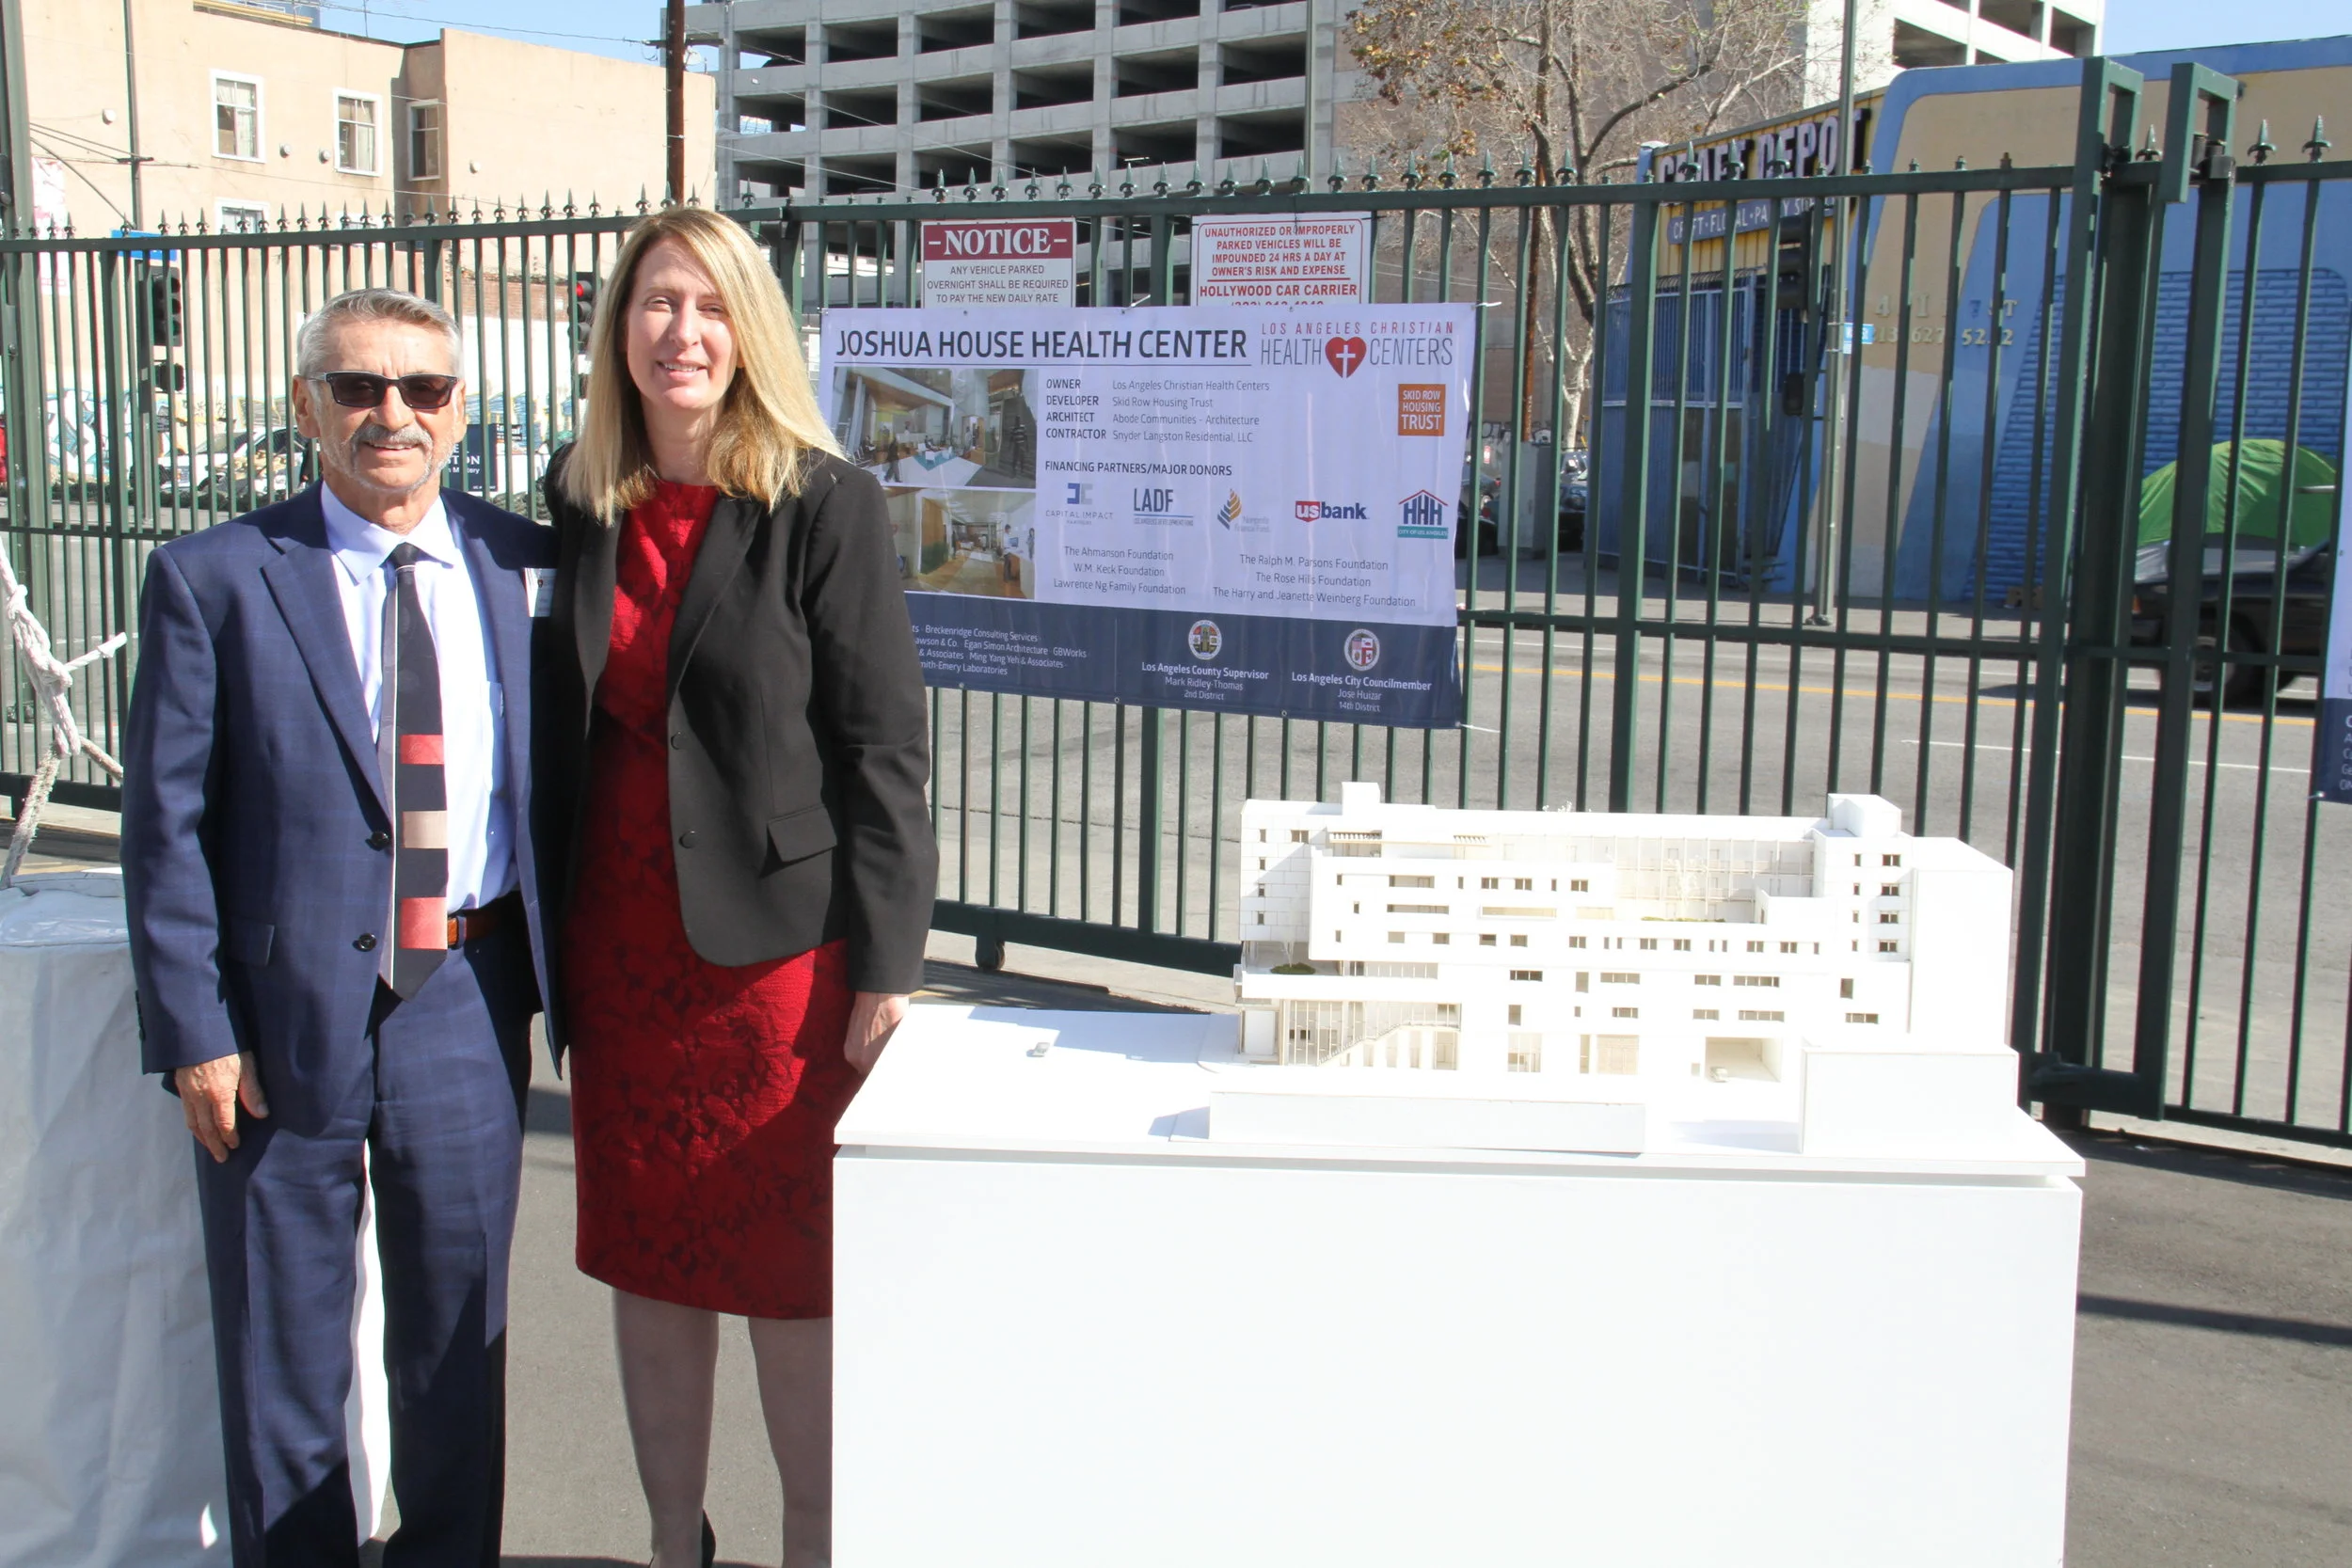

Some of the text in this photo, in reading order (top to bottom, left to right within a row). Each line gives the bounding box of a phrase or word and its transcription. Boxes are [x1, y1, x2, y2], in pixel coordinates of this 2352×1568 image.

[1673, 217, 1704, 239] CFT
[1710, 208, 1748, 232] FLOAL
[1755, 198, 1789, 224] PAY
[1205, 225, 1356, 237] UNAUTHORIZED OR IMPROPERLY
[944, 229, 1051, 255] NOTICE
[1216, 238, 1341, 250] PARKED VEHICLES WILL BE
[1213, 251, 1345, 263] IMPOUNDED 24 HRS A DAY AT
[950, 265, 1044, 275] ANY VEHICLE PARKED
[1212, 265, 1345, 277] OWNER'S RISK AND EXPENSE
[928, 279, 1069, 289] OVERNIGHT SHALL BE REQUIRED
[1200, 284, 1358, 296] HOLLYWOOD CAR CARRIER
[936, 294, 947, 303] TO
[949, 294, 966, 303] PAY
[1008, 293, 1033, 302] DAILY
[1036, 293, 1058, 302] RATE
[1262, 322, 1454, 335] LOS ANGELES CHRISTIAN
[1873, 326, 1898, 343] 13
[1962, 328, 2013, 345] 522
[835, 329, 1248, 358] JOSHUA HOUSE HEALTH CENTER
[1261, 338, 1453, 366] HEALTH CENTERS
[1046, 379, 1270, 392] OWNER Los Angeles Christian Health Centers
[1046, 395, 1214, 410] DEVELOPER Skid Row Housing Trust
[1403, 390, 1441, 400] SKID ROW
[1403, 403, 1440, 413] HOUSING
[1046, 412, 1095, 422] ARCHITECT
[1112, 414, 1139, 423] Abode
[1140, 414, 1197, 424] Communities
[1206, 415, 1260, 425] Architecture
[1401, 414, 1442, 430] TRUST
[1046, 428, 1106, 439] CONTRACTOR
[1113, 430, 1141, 442] Snyder
[1143, 431, 1184, 443] Langston
[1237, 433, 1253, 442] LLC
[1045, 461, 1232, 476] FINANCING PARTNERS/MAJOR DONORS
[1133, 488, 1173, 512] LADF
[1045, 510, 1079, 518] CAPITAL
[1403, 494, 1442, 526] HHH
[1064, 546, 1174, 561] The Ahmanson Foundation
[1097, 563, 1116, 574] Keck
[1118, 565, 1165, 577] Foundation
[1240, 554, 1256, 564] The
[1258, 555, 1282, 567] Ralph
[1298, 557, 1333, 568] Parsons
[1336, 559, 1389, 571] Foundation
[1054, 578, 1185, 594] Lawrence Ng Family Foundation
[1256, 572, 1371, 586] The Rose Hills Foundation
[1214, 586, 1416, 607] The Harry and Jeanette Weinberg Foundation
[925, 625, 972, 639] Breckenridge
[974, 628, 1009, 641] Consulting
[1009, 631, 1038, 641] Services
[914, 637, 939, 646] awson
[964, 640, 981, 651] Egan
[983, 641, 1005, 651] Simon
[1006, 642, 1049, 656] Architecture
[918, 648, 1064, 669] & Associates Ming Yang Yeh & Associates
[920, 660, 1008, 675] mith-Emery Laboratories
[1141, 662, 1269, 680] Los Angeles County Supervisor
[1165, 676, 1244, 691] Mark Ridley-Thomas
[1292, 672, 1432, 691] Los Angeles City Councilmember
[1184, 689, 1225, 701] 2nd District
[1358, 690, 1382, 701] Huizar
[1339, 701, 1380, 712] 14th District
